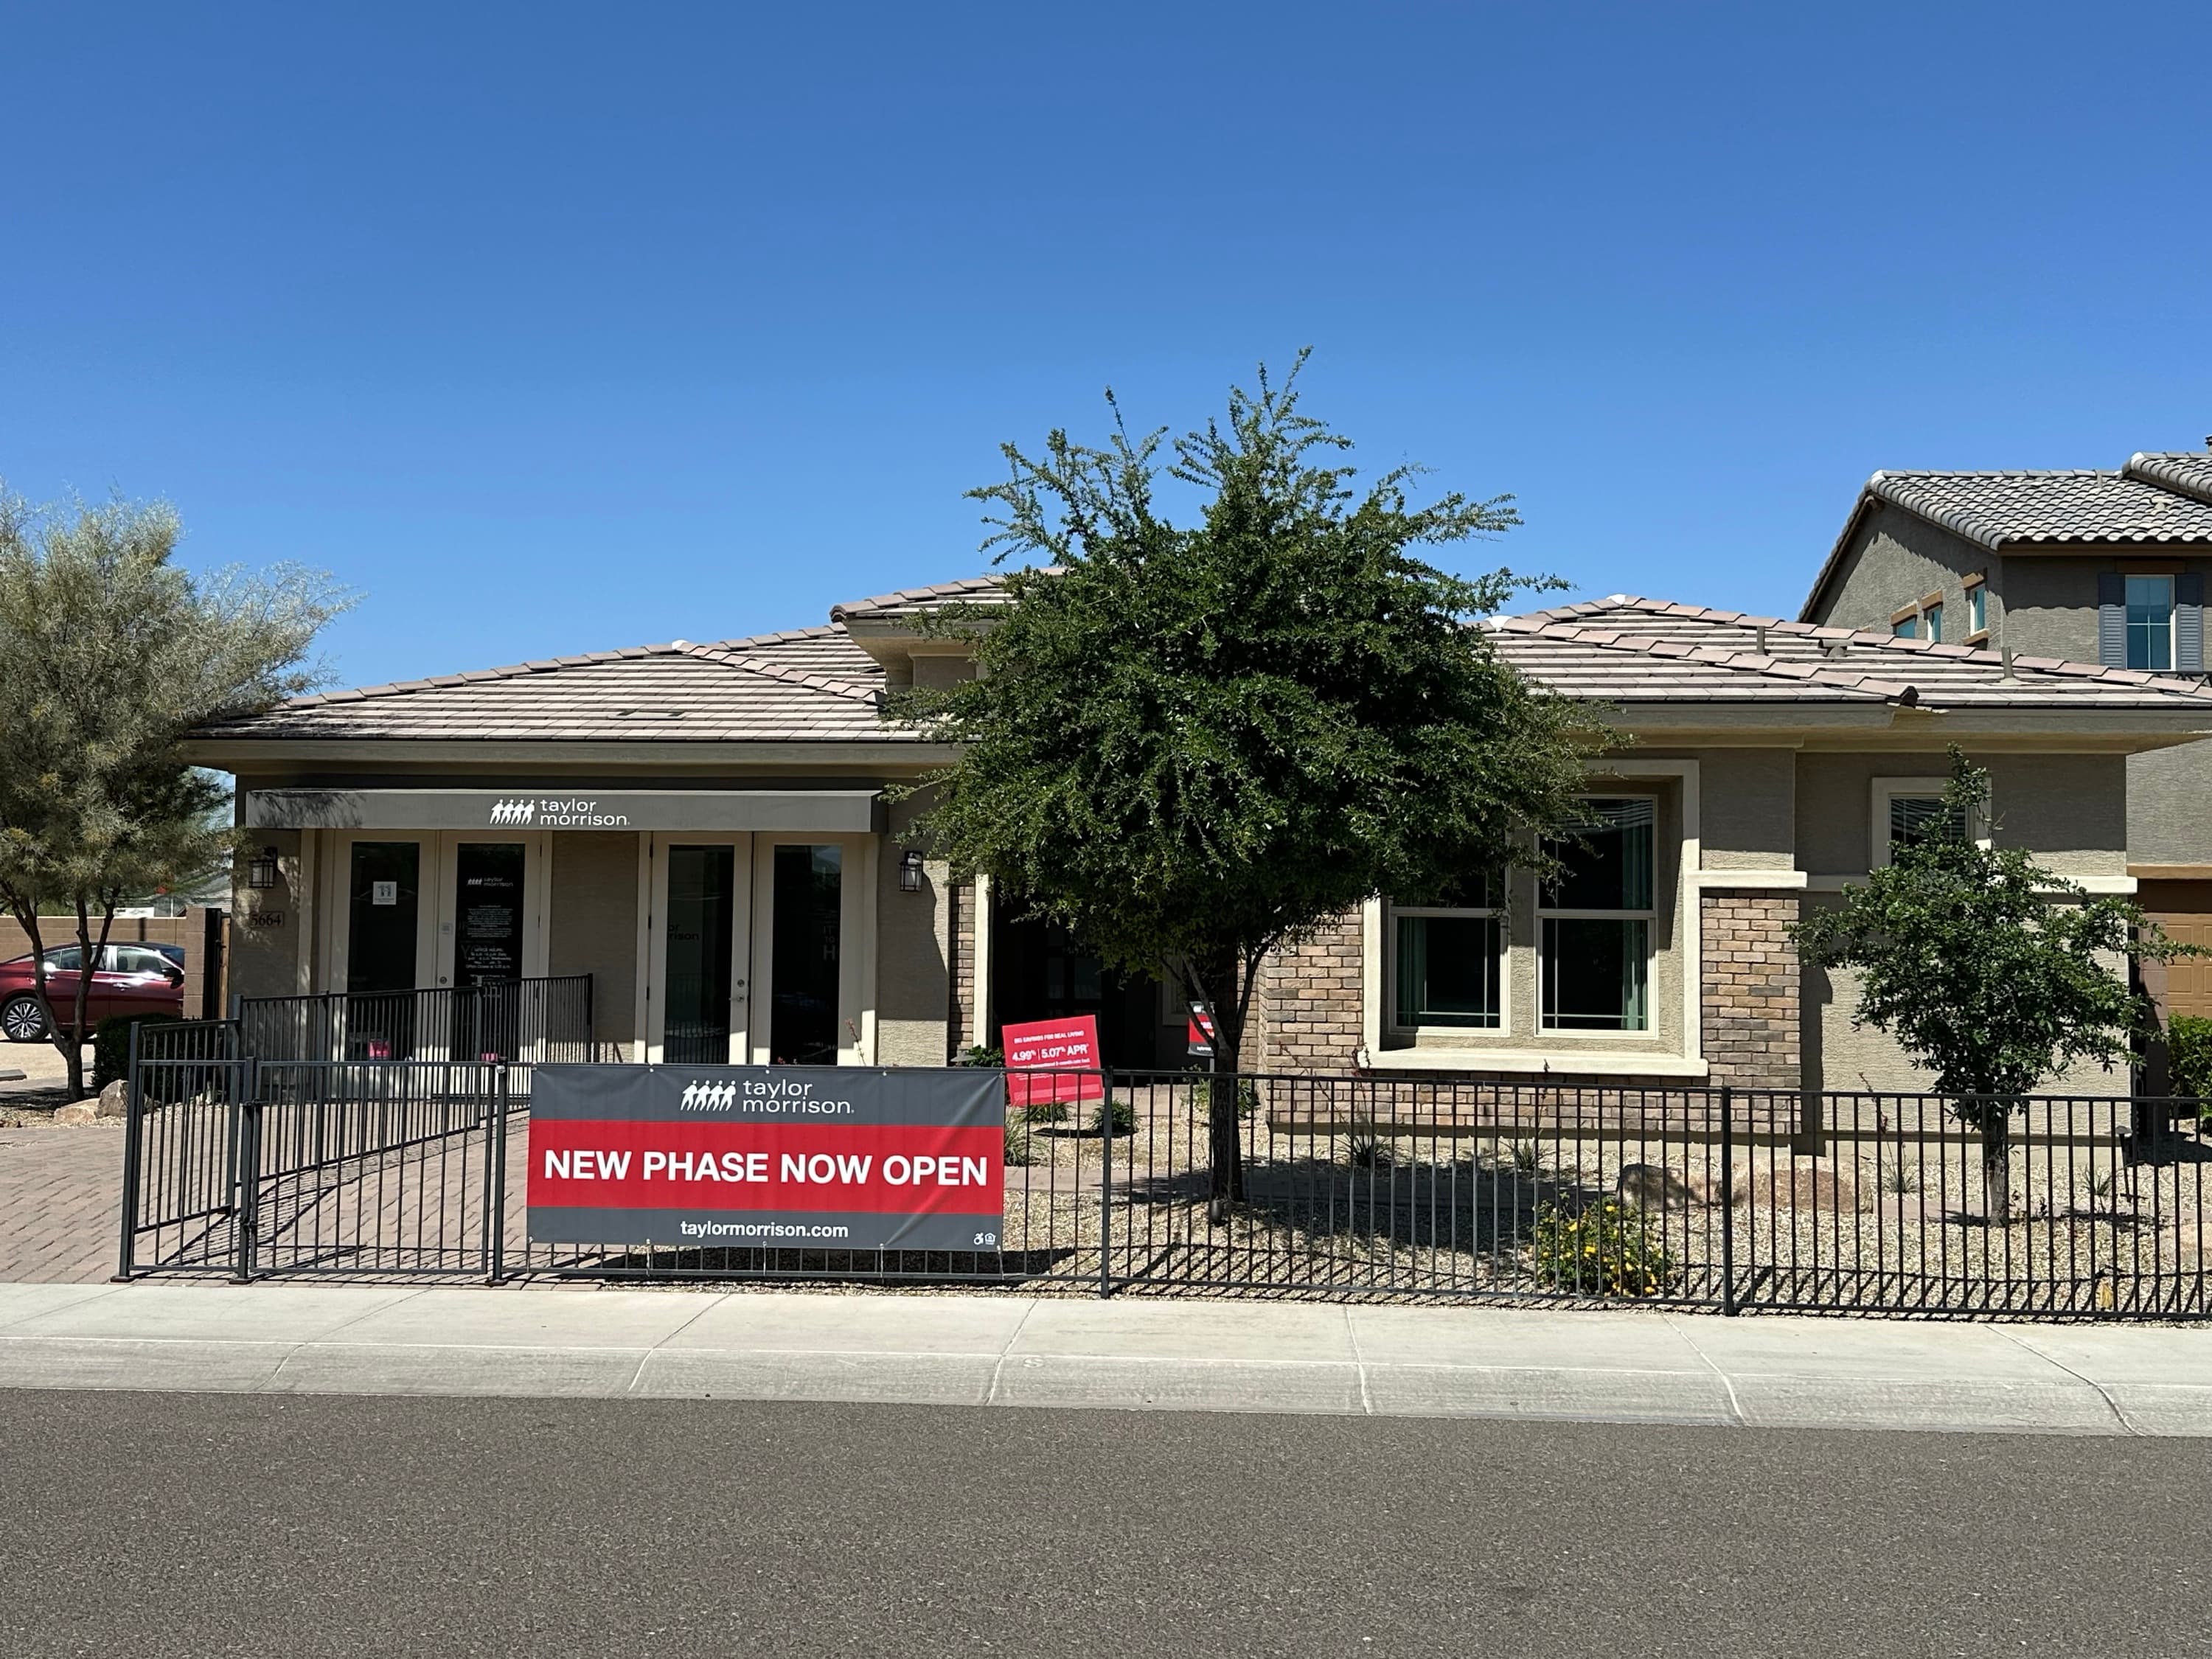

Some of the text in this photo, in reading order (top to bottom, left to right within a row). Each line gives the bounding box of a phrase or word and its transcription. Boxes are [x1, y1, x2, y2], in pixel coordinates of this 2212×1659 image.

[540, 798, 597, 814] taylor
[540, 812, 627, 826] morrison
[251, 914, 281, 927] 5664
[742, 1079, 813, 1099] taylor
[742, 1096, 850, 1114] morrison
[545, 1150, 987, 1186] NEW PHASE NOW OPEN
[680, 1220, 849, 1238] taylormorrison.com
